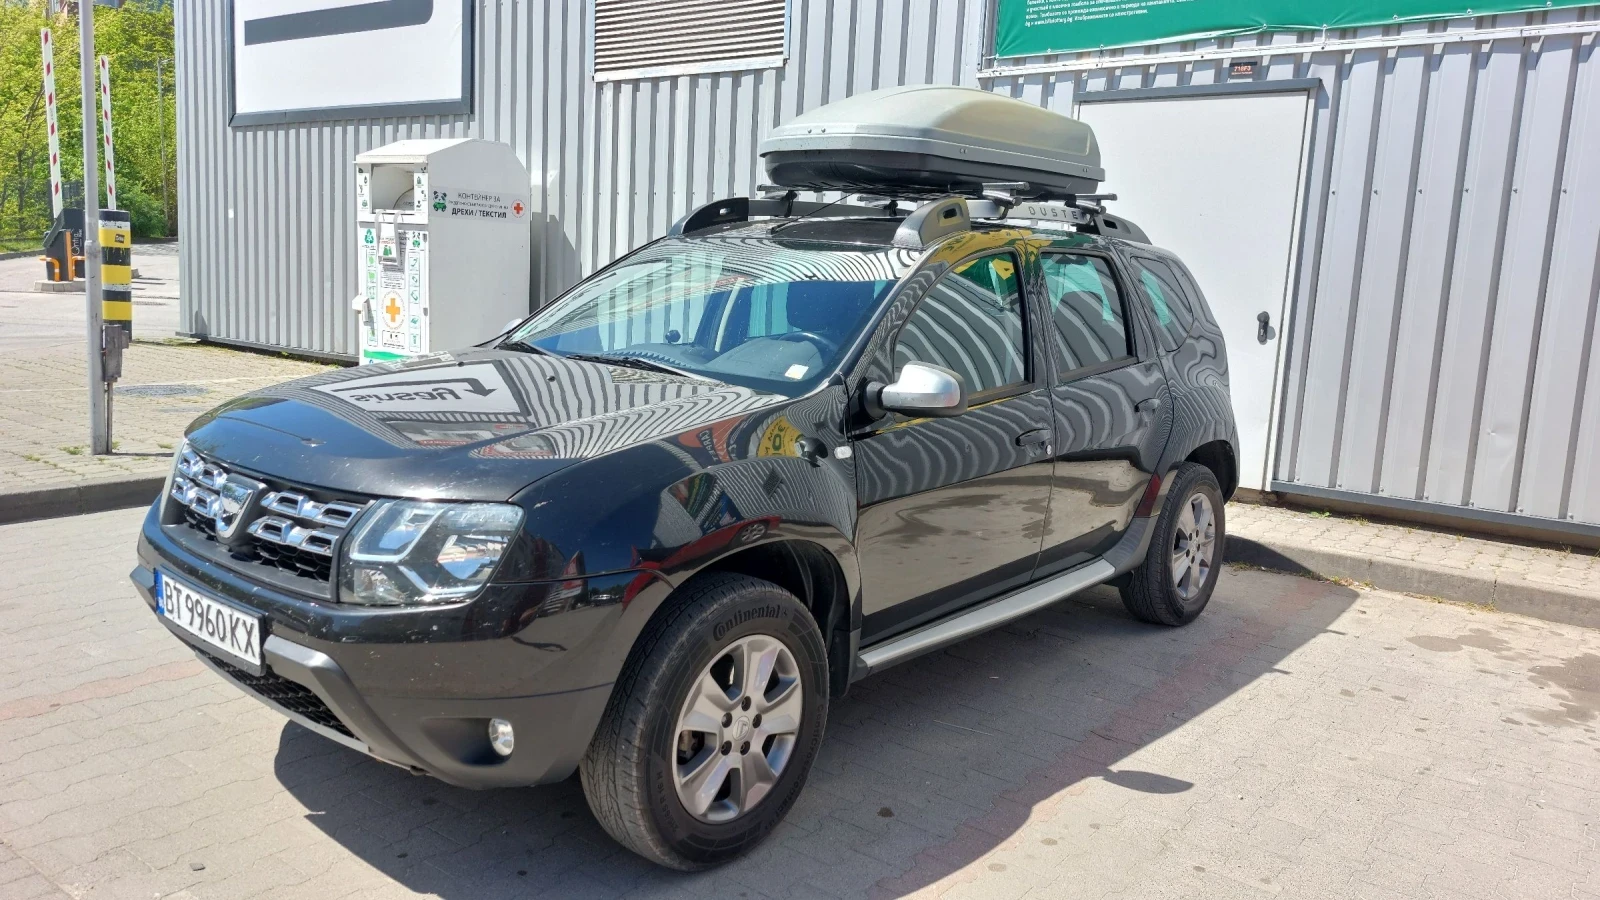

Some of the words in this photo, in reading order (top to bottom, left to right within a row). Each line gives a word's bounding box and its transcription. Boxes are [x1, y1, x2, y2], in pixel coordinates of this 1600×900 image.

[451, 207, 474, 216] ДРЕХИ
[478, 209, 507, 219] ТЕКСТИЛ
[164, 581, 182, 619] BT
[185, 593, 226, 642] 9960
[229, 615, 256, 658] KX
[713, 604, 781, 641] Continental
